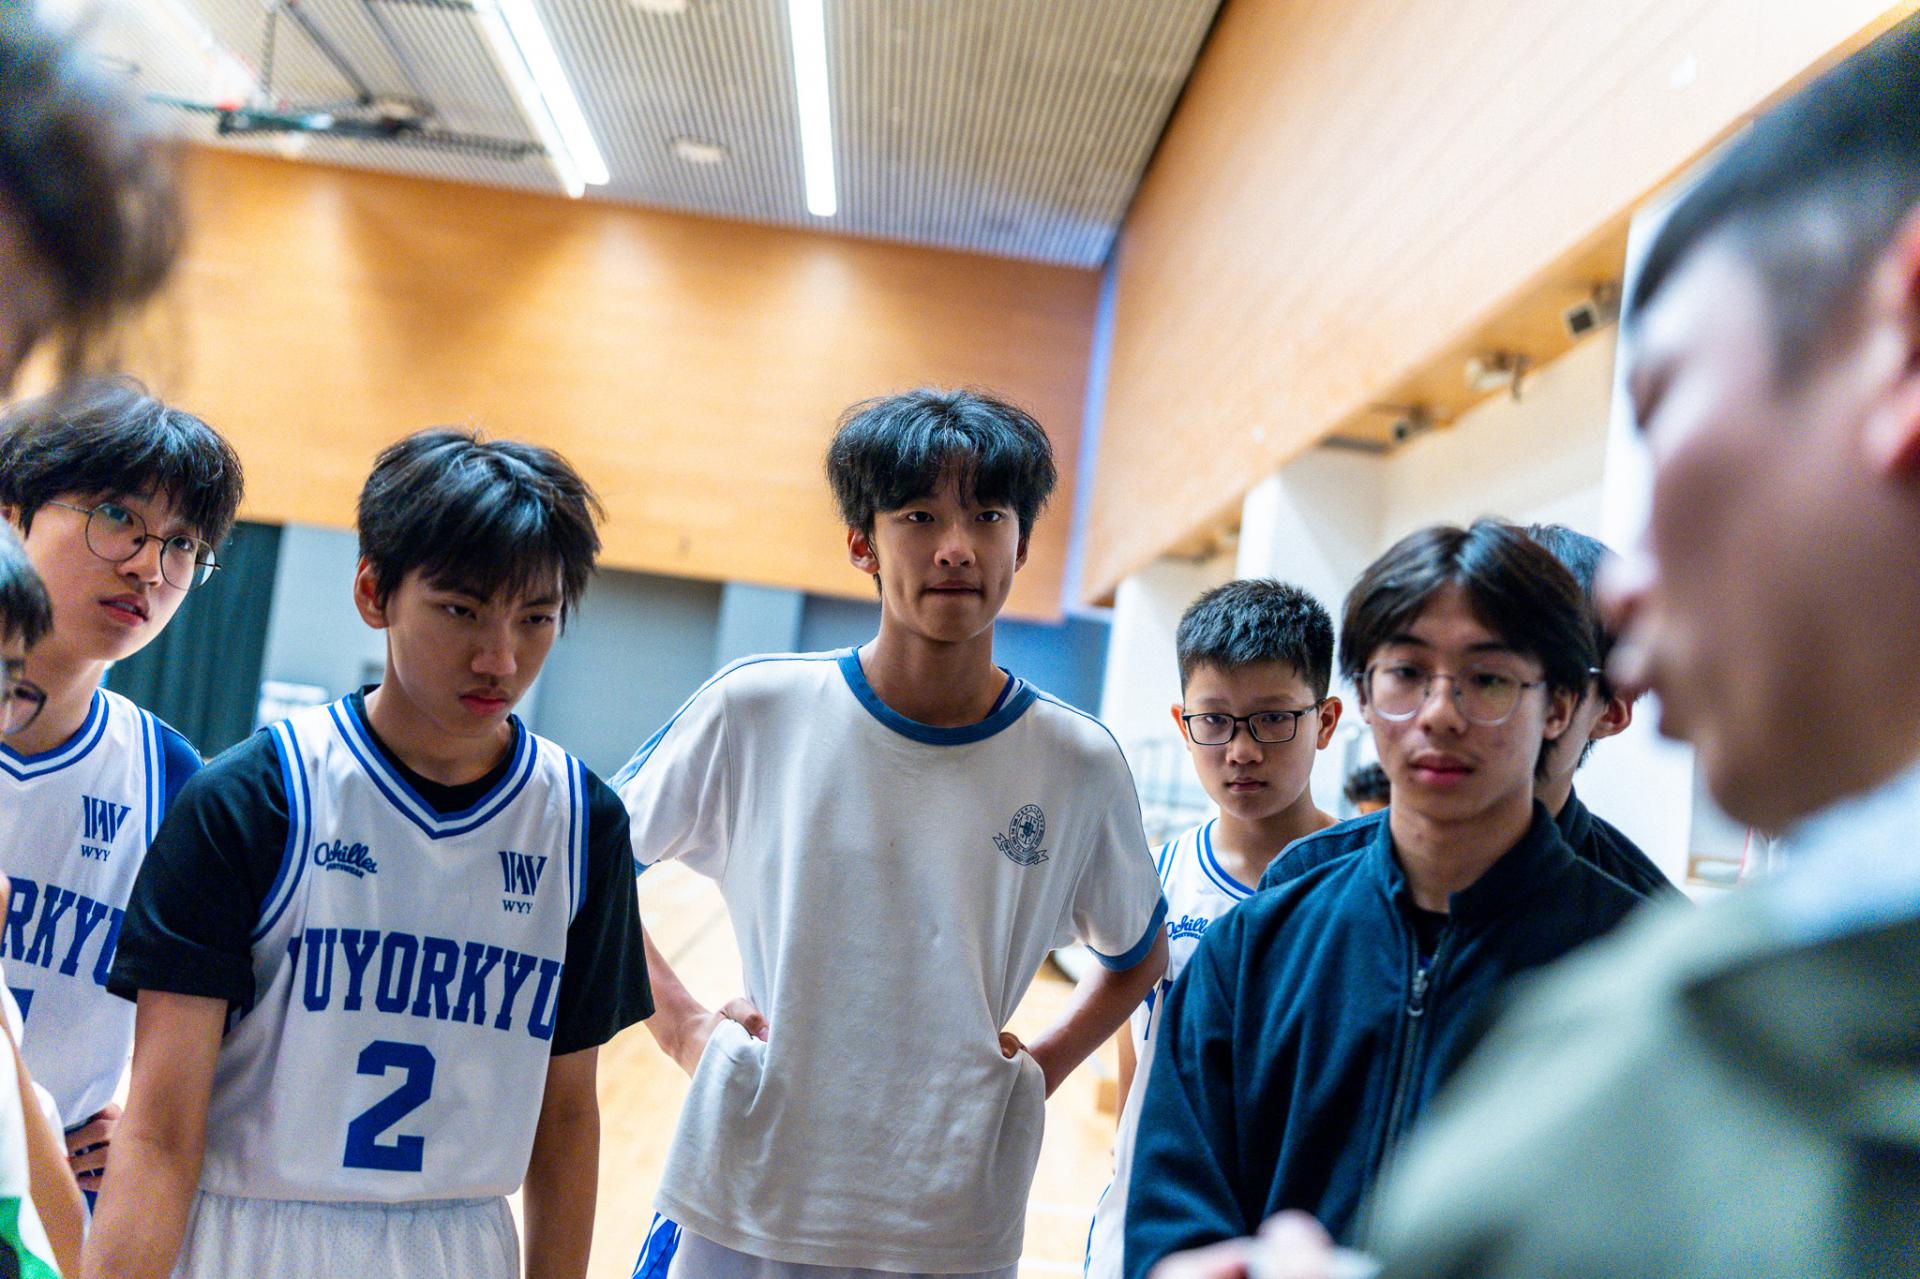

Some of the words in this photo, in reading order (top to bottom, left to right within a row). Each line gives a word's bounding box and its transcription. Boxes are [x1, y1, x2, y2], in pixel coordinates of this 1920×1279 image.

[81, 844, 111, 862] WYY
[502, 899, 533, 915] WYY
[1166, 914, 1209, 938] Achill
[342, 1039, 436, 1172] 2
